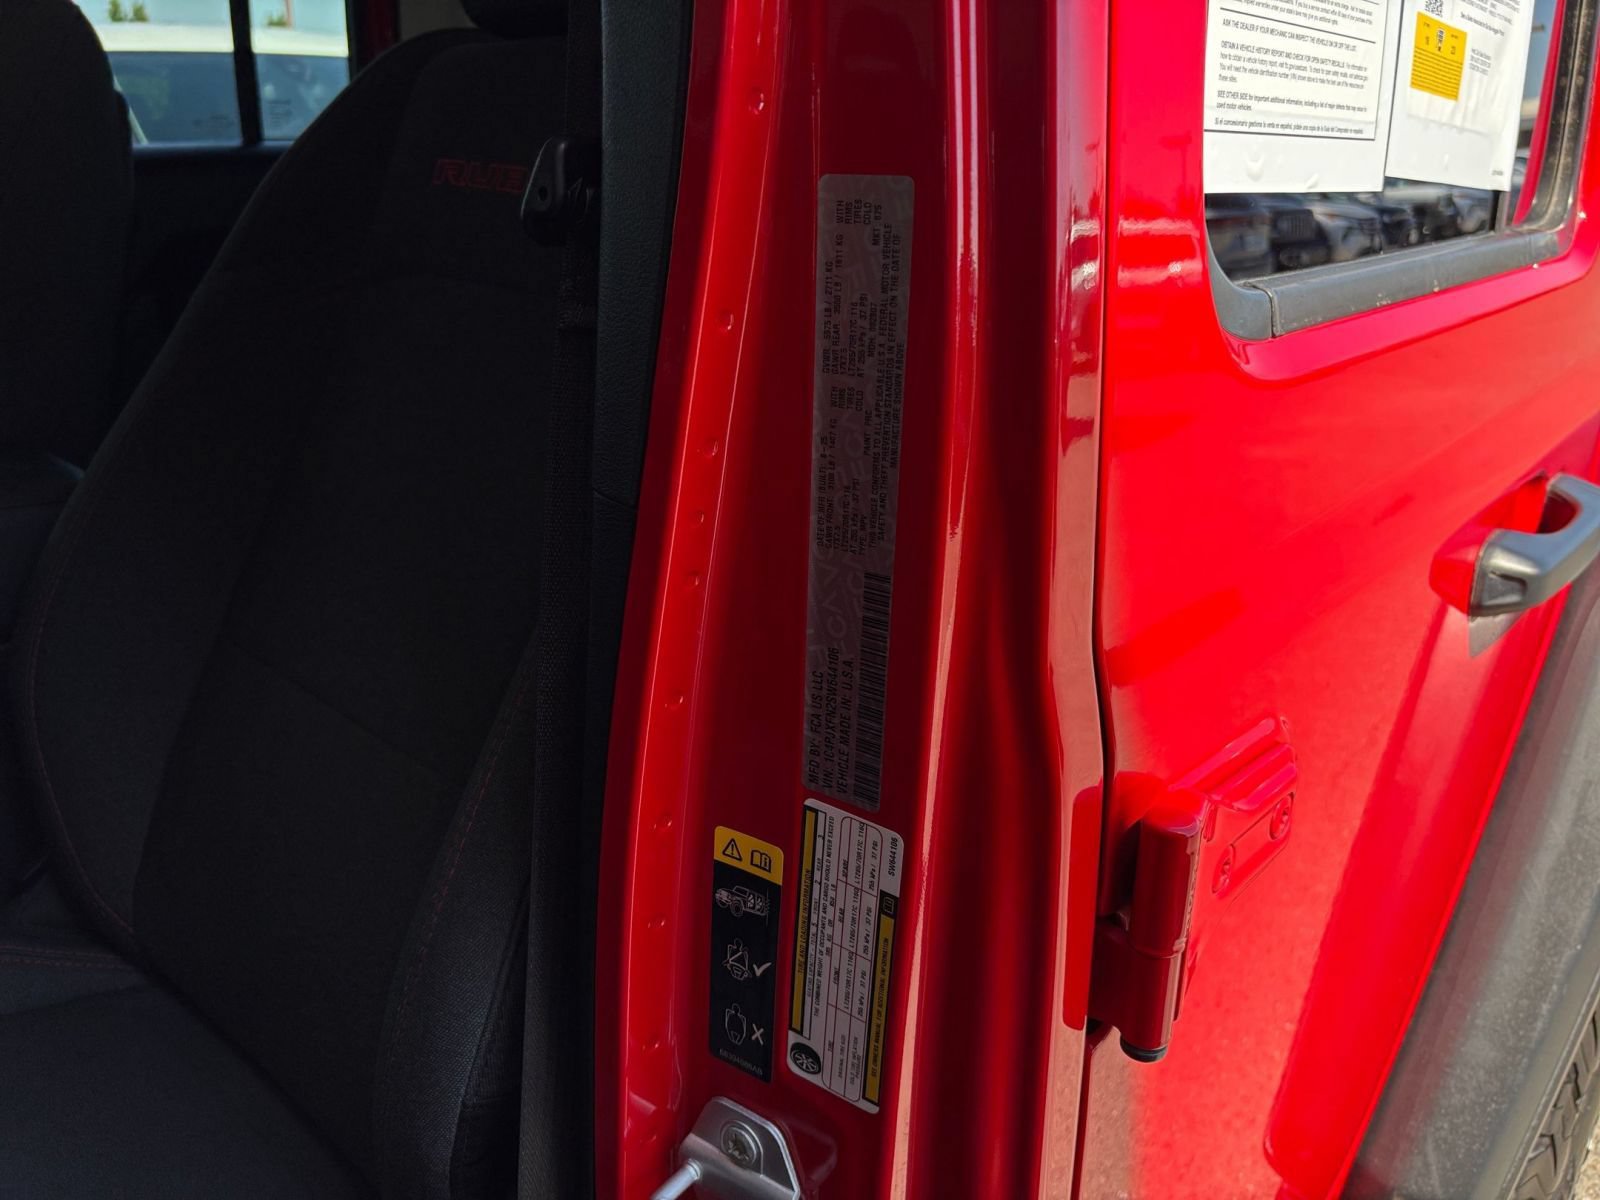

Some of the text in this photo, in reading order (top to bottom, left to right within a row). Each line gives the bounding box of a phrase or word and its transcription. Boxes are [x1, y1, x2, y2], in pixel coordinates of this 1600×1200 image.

[836, 200, 844, 224] WITH
[845, 202, 853, 224] RIMS
[853, 199, 862, 224] TIRES
[863, 202, 872, 226] COLD
[835, 233, 844, 246] KG
[882, 223, 892, 260] VEHICLE
[825, 261, 834, 273] KG
[880, 264, 890, 294] MOTOR
[879, 298, 888, 336] FEDERAL
[878, 233, 901, 540] SAFETY AND THEFT PREVENTION STANDARDS IN EFFECT ON THE DATE OF
[893, 374, 903, 404] SHOWN
[855, 390, 864, 412] COLD
[873, 421, 882, 436] ALL
[889, 408, 901, 468] MANUFACTURE
[872, 439, 881, 448] TO
[871, 451, 881, 496] CONFORMS
[870, 497, 880, 529] VEHICLE
[812, 670, 824, 692] LLC
[811, 694, 823, 710] US
[810, 713, 822, 734] FCA
[837, 658, 854, 794] VEHICLE MADE IN: U.S.A.
[808, 759, 820, 784] MFD
[822, 768, 834, 788] VIN:
[888, 836, 898, 876] SW644106
[824, 858, 832, 882] SHOULD
[802, 868, 812, 914] INFORMATION
